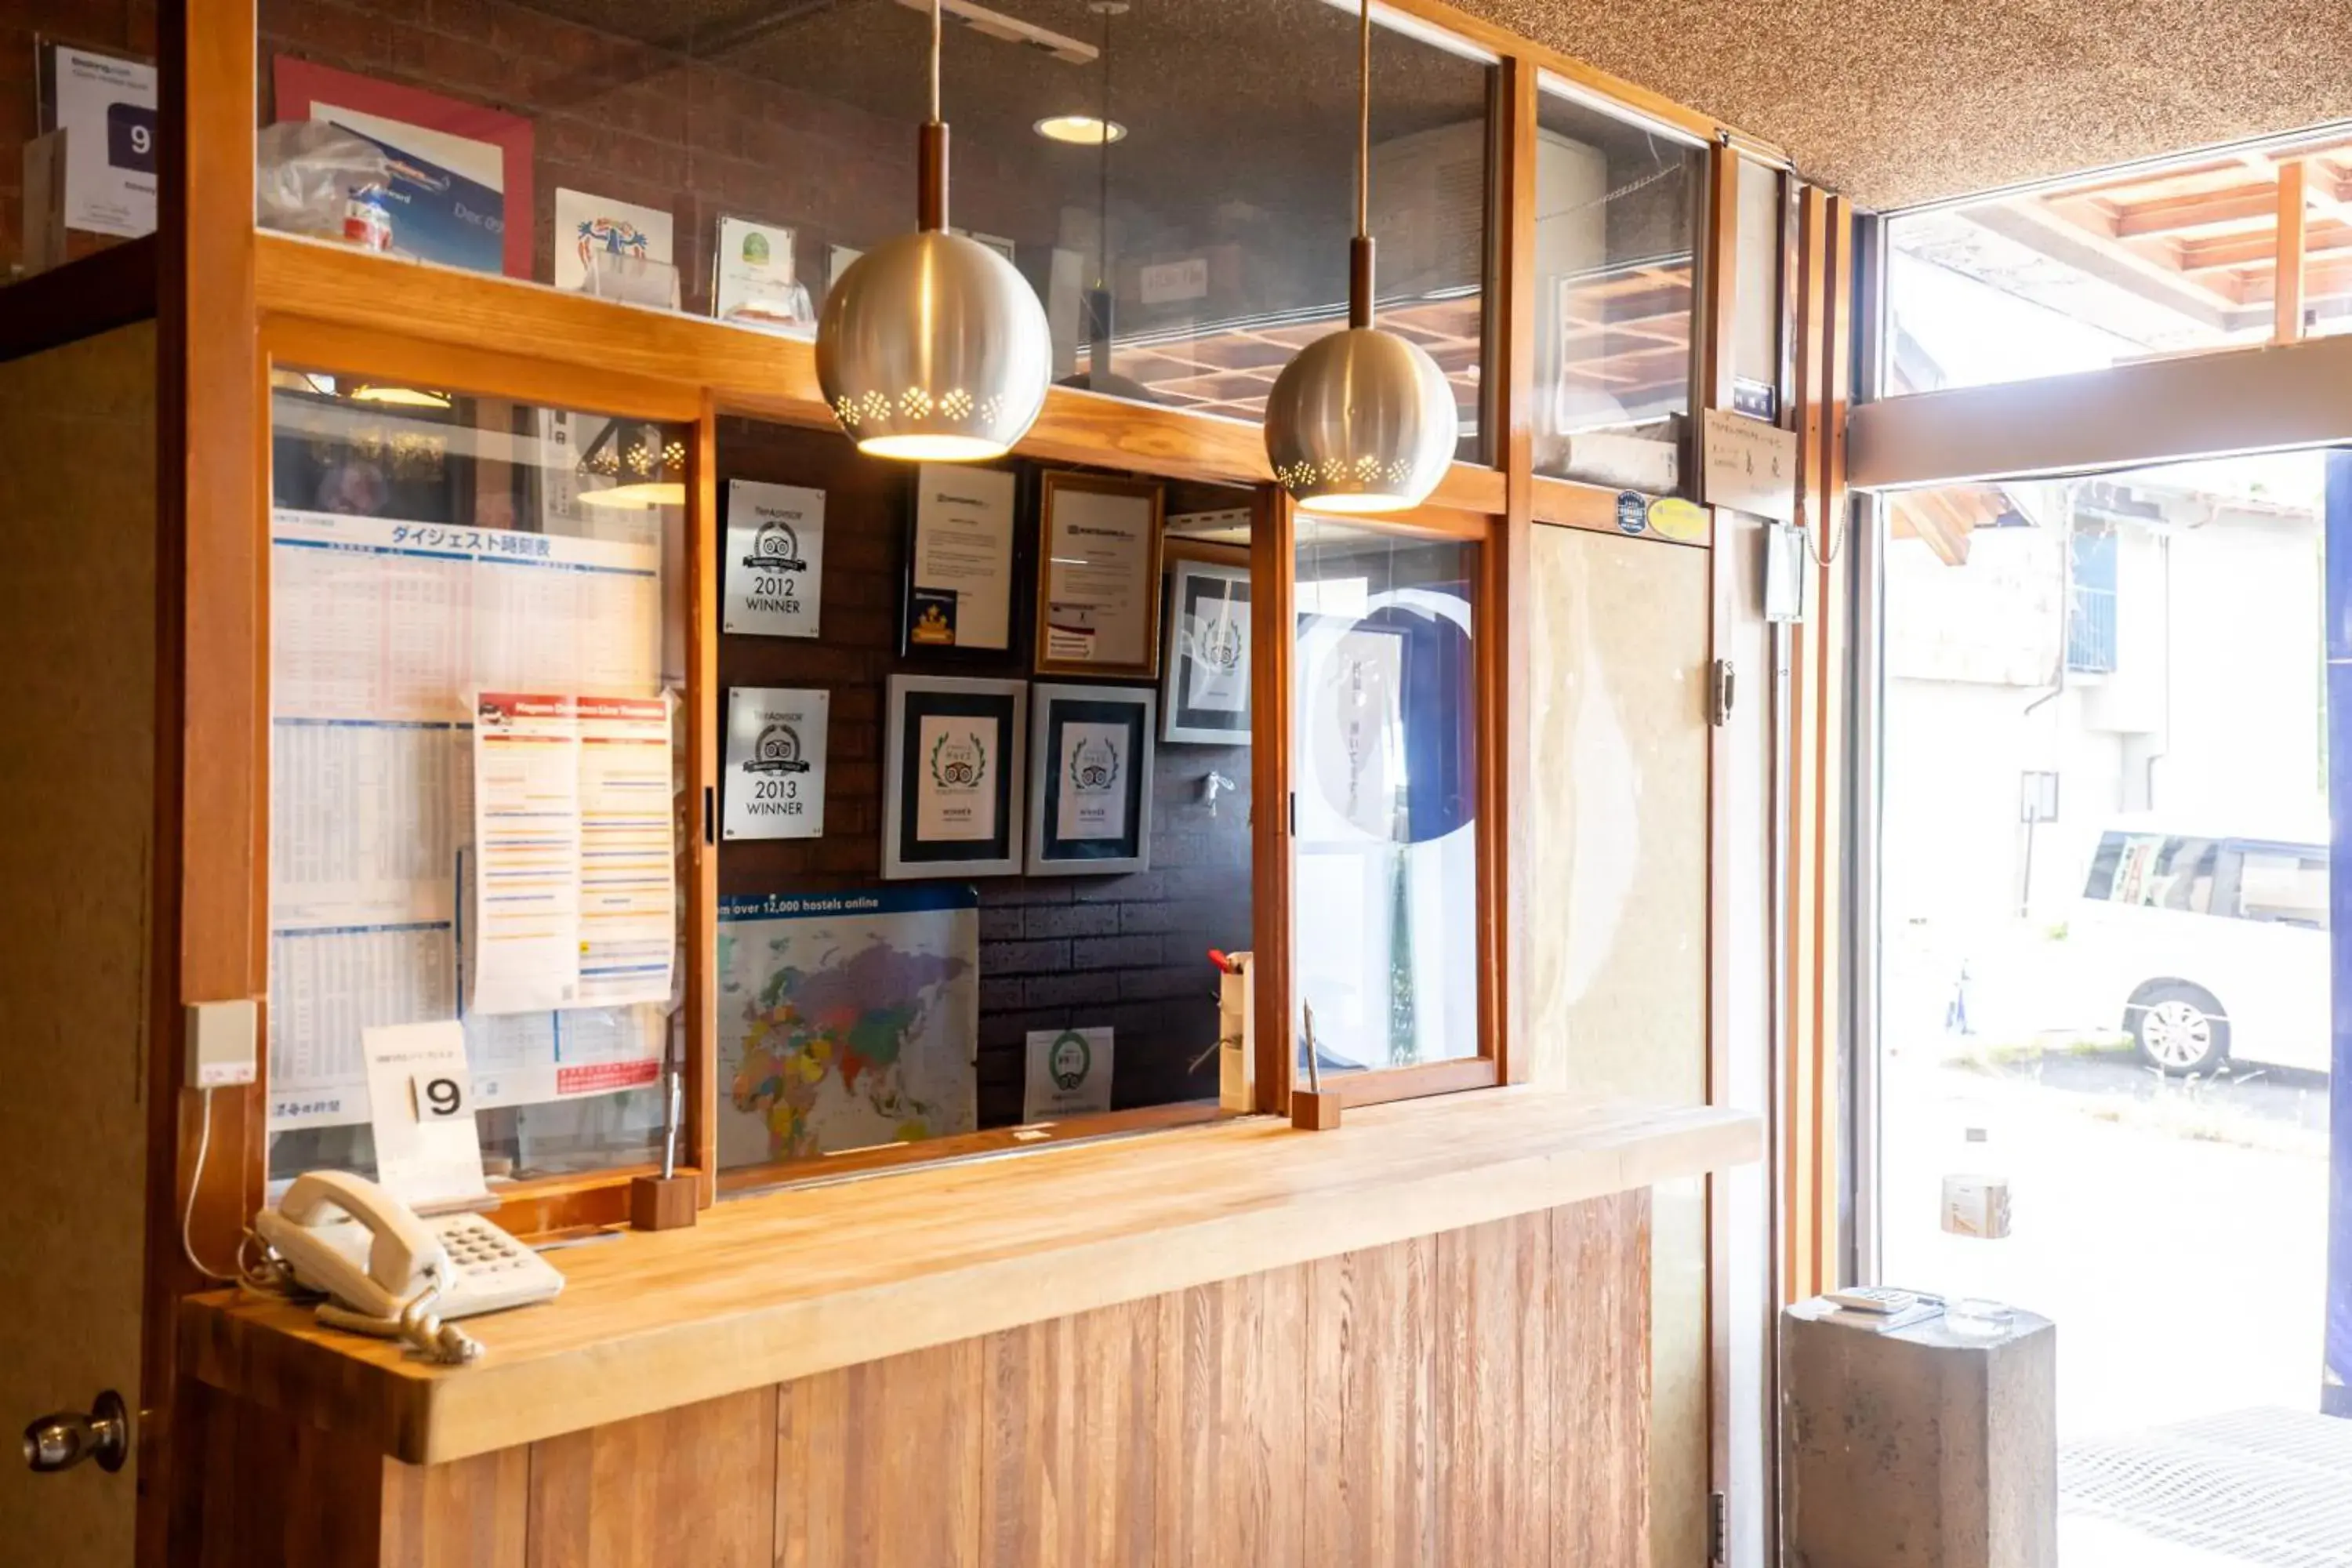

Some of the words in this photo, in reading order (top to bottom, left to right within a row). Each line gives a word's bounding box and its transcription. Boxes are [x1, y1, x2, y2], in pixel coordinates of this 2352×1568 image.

[755, 576, 795, 597] 2012
[746, 597, 800, 614] WINNER
[755, 781, 797, 799] 2013
[746, 802, 803, 815] WINNER
[733, 903, 759, 914] over
[764, 899, 800, 914] 12,000
[803, 898, 841, 910] hostels
[844, 897, 879, 909] online
[426, 1078, 461, 1116] 9
